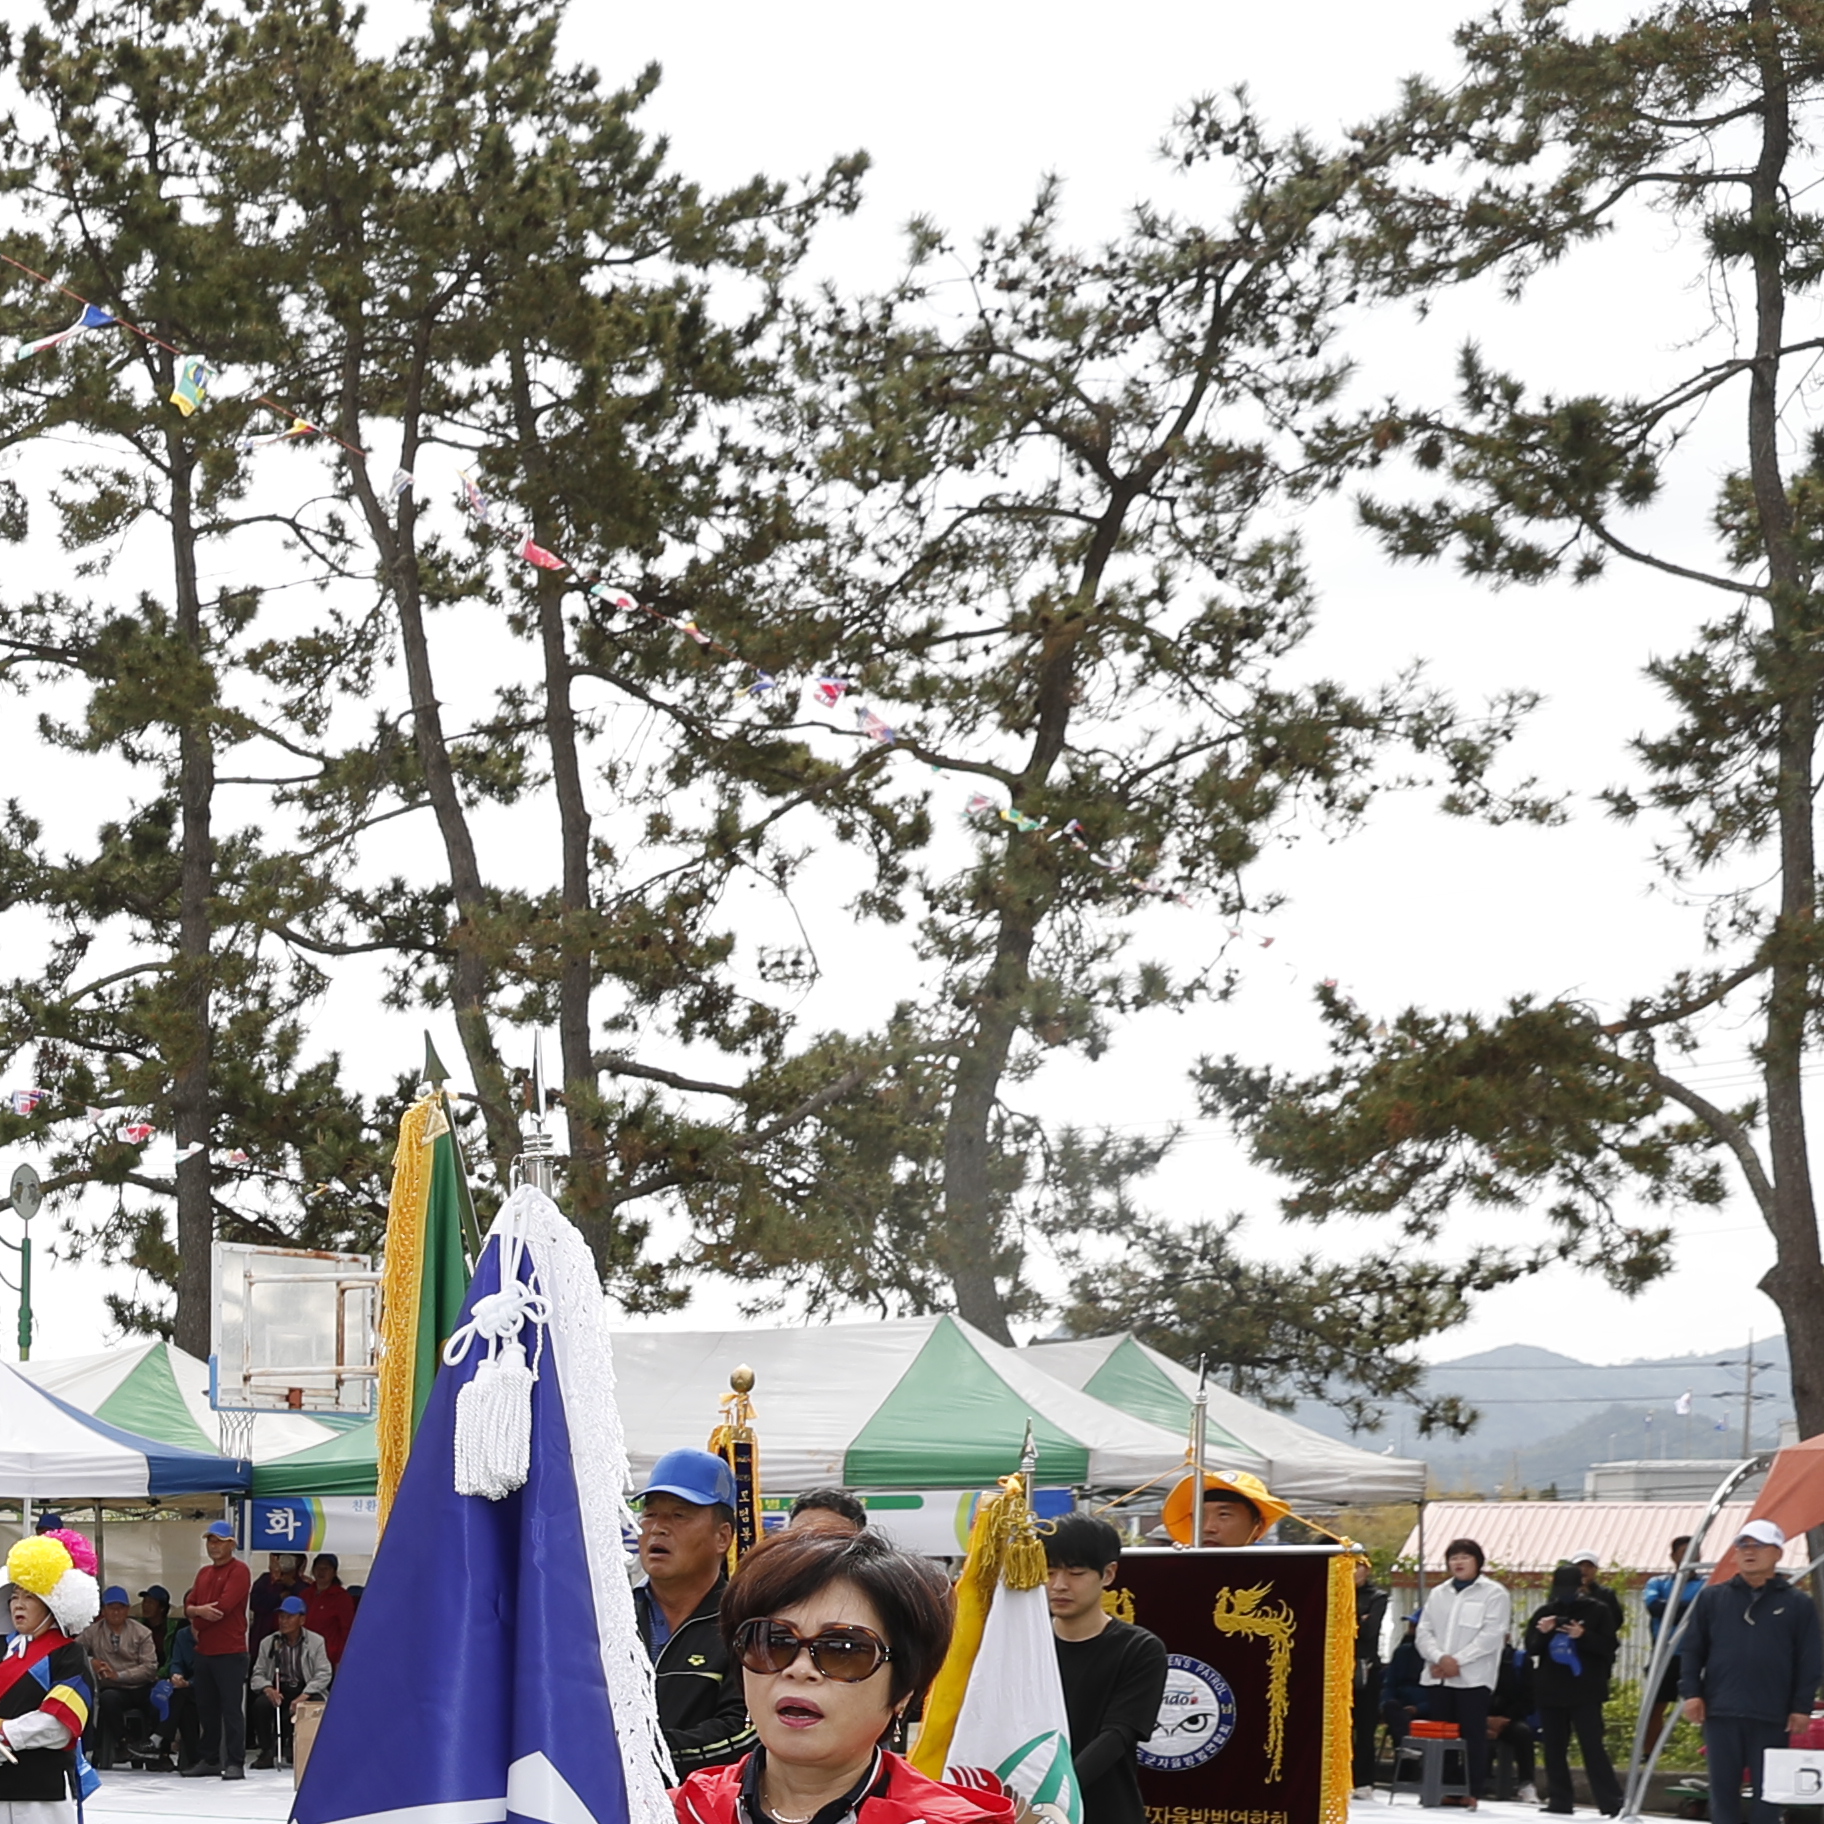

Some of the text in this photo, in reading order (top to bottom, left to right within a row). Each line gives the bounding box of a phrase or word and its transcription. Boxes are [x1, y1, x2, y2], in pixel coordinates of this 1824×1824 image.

[264, 1507, 302, 1542] 화
[1195, 1663, 1228, 1698] PATROL
[1162, 1693, 1191, 1707] ndo
